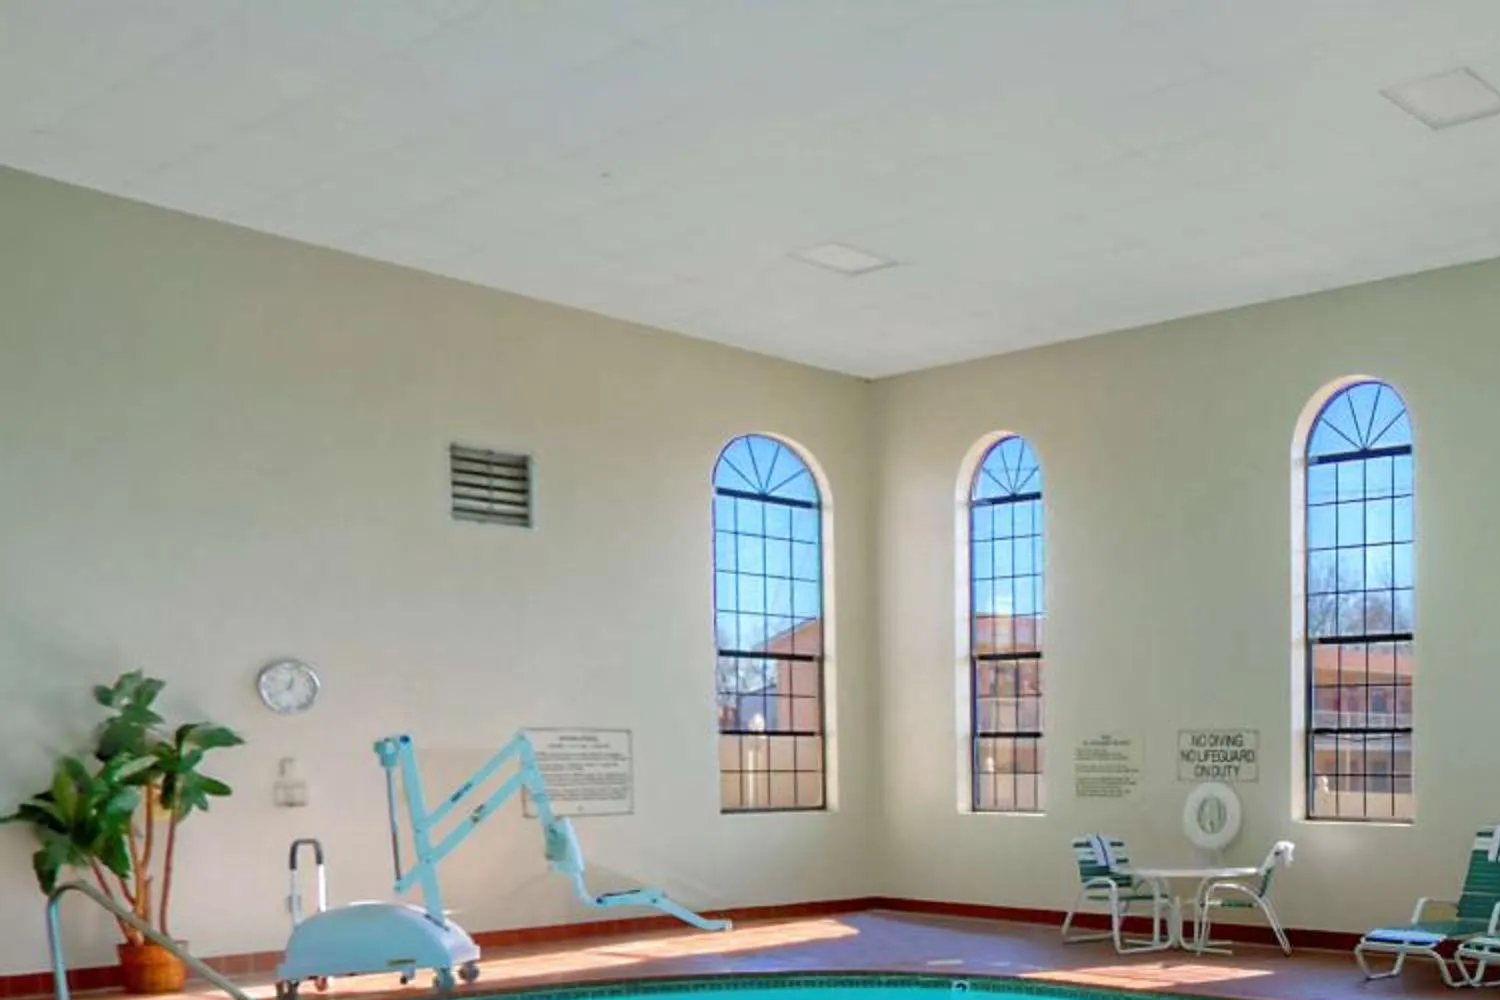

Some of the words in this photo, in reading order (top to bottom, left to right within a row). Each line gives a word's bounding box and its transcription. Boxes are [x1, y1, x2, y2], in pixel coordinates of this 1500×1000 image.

[1191, 735, 1207, 747] NO
[1209, 734, 1244, 747] DIVING
[1181, 749, 1197, 762] NO
[1199, 749, 1255, 763] LIFEGUARD
[1194, 765, 1211, 778] ON
[1212, 765, 1240, 778] DUTY
